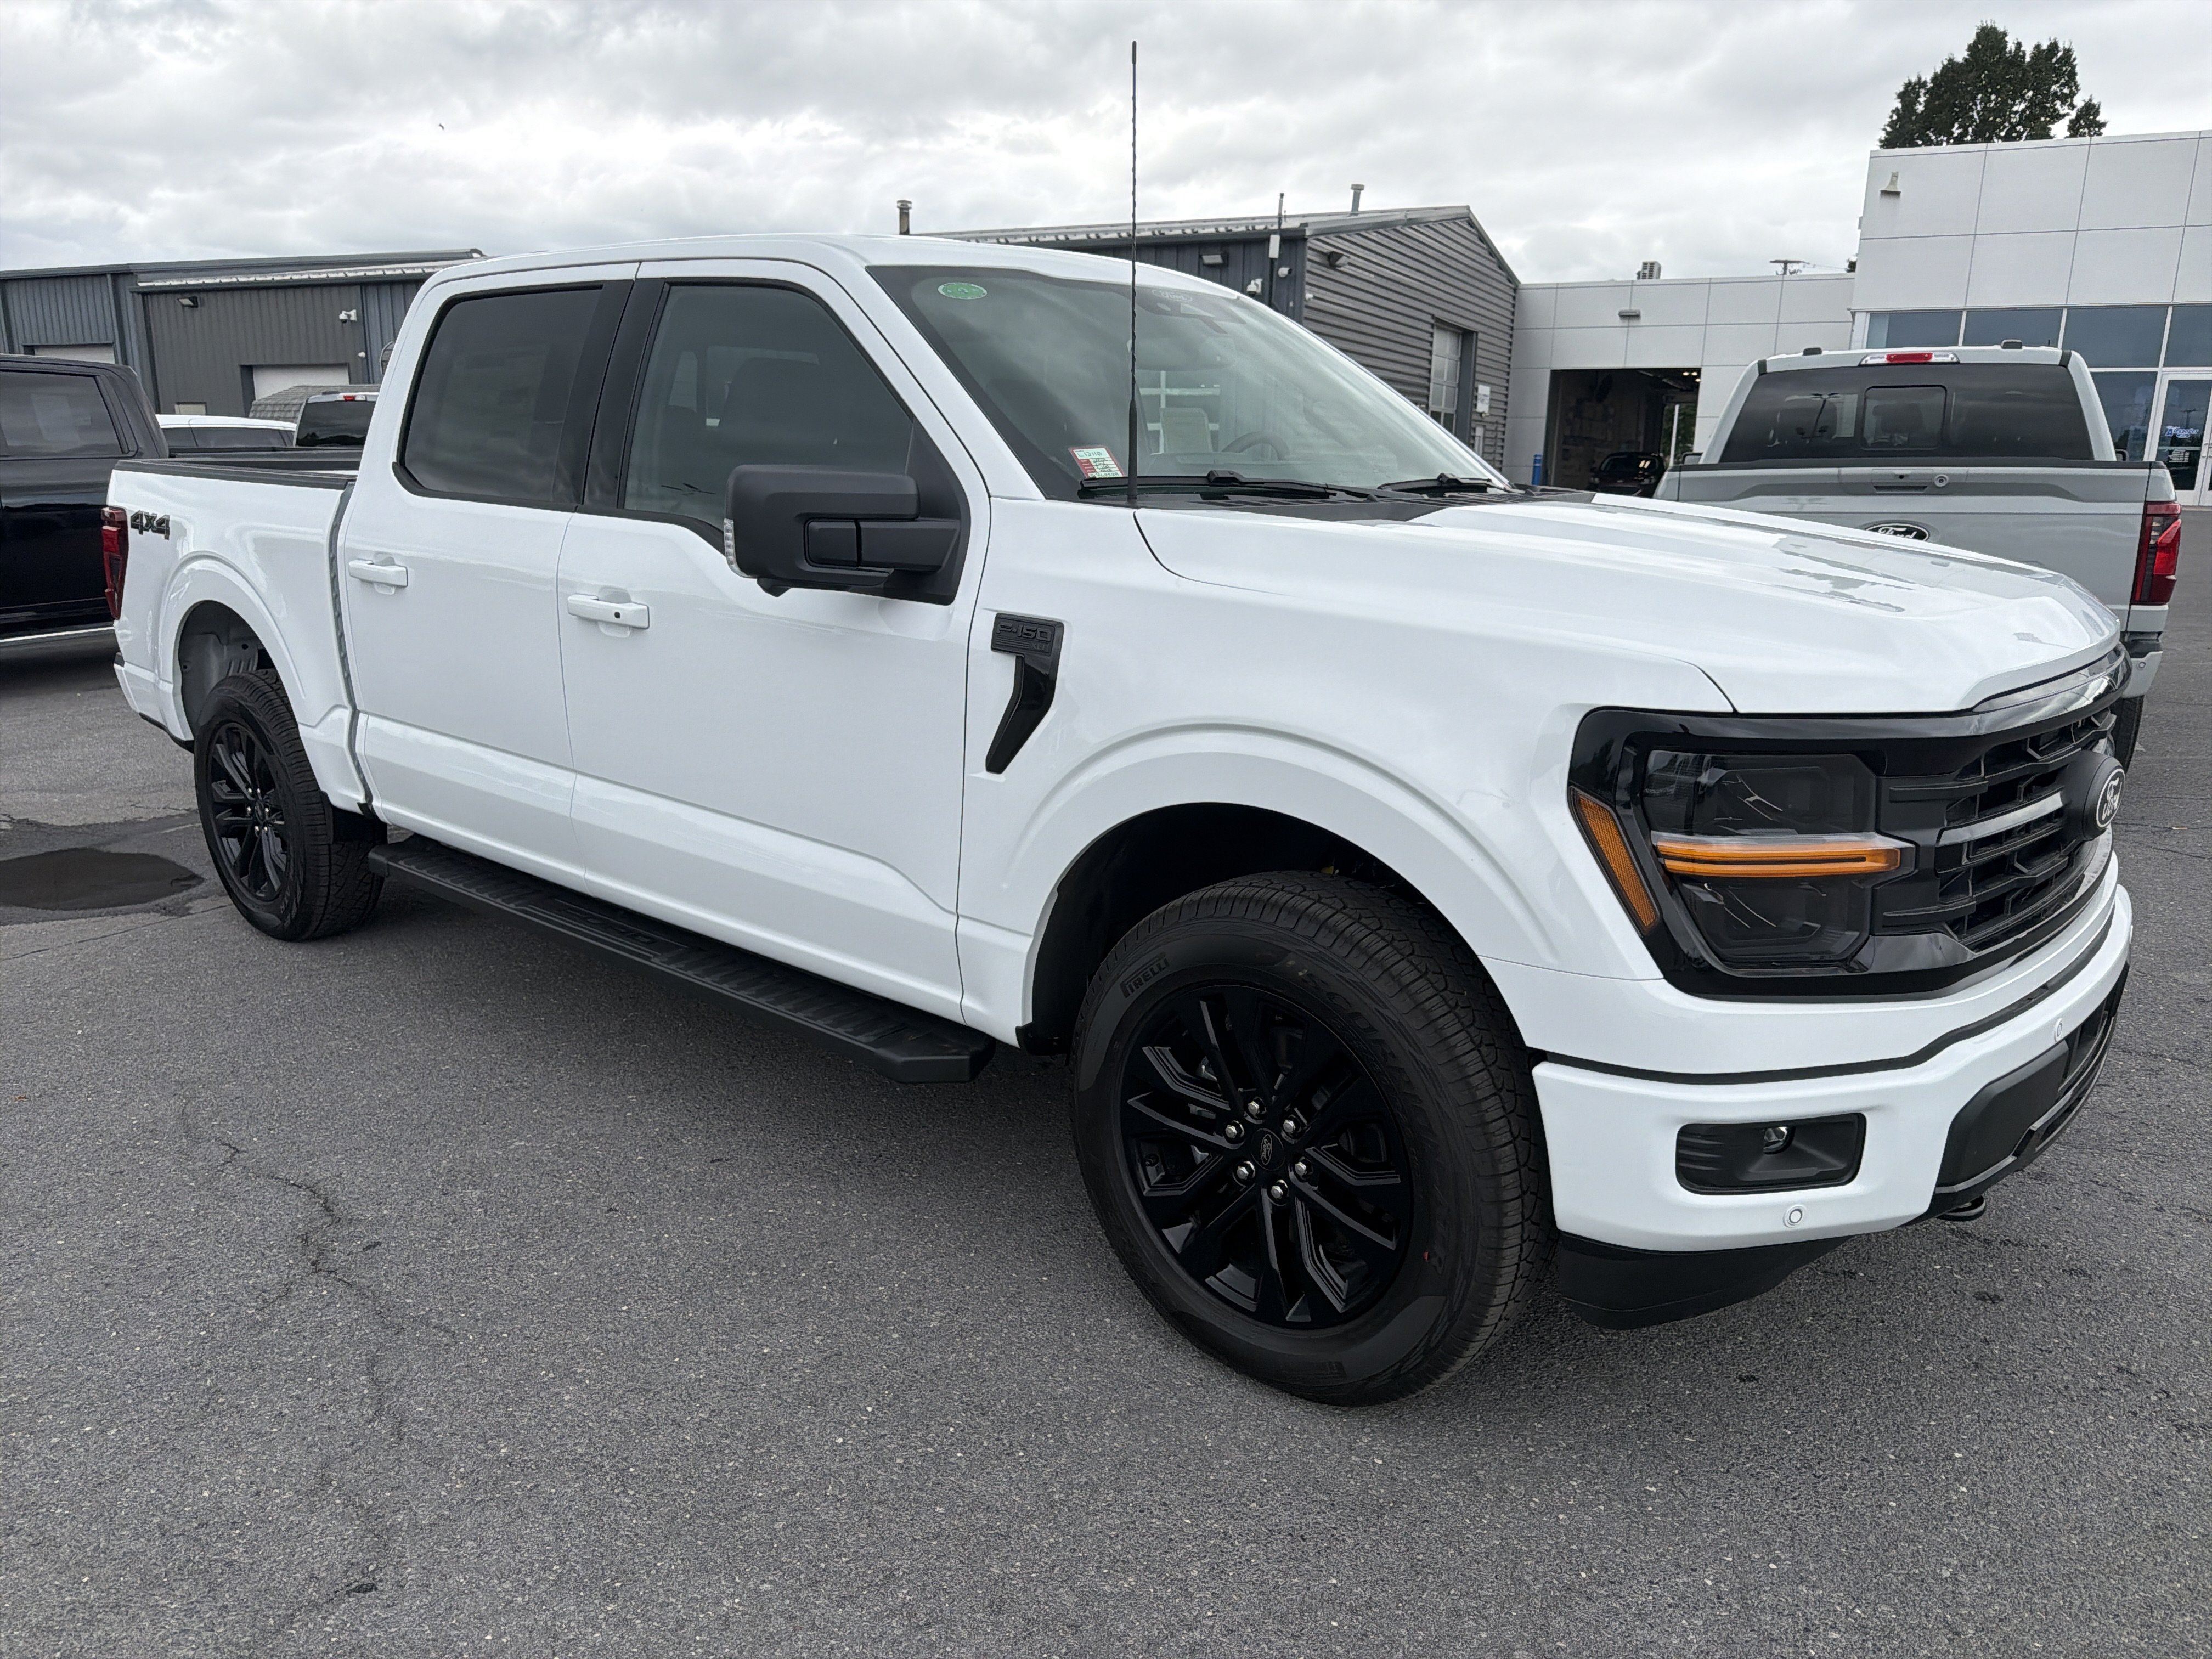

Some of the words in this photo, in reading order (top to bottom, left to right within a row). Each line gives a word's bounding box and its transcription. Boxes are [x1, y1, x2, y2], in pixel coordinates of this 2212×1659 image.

[996, 622, 1052, 642] F-150
[2102, 776, 2123, 821] Ford
[1119, 951, 1171, 999] PIRELLI
